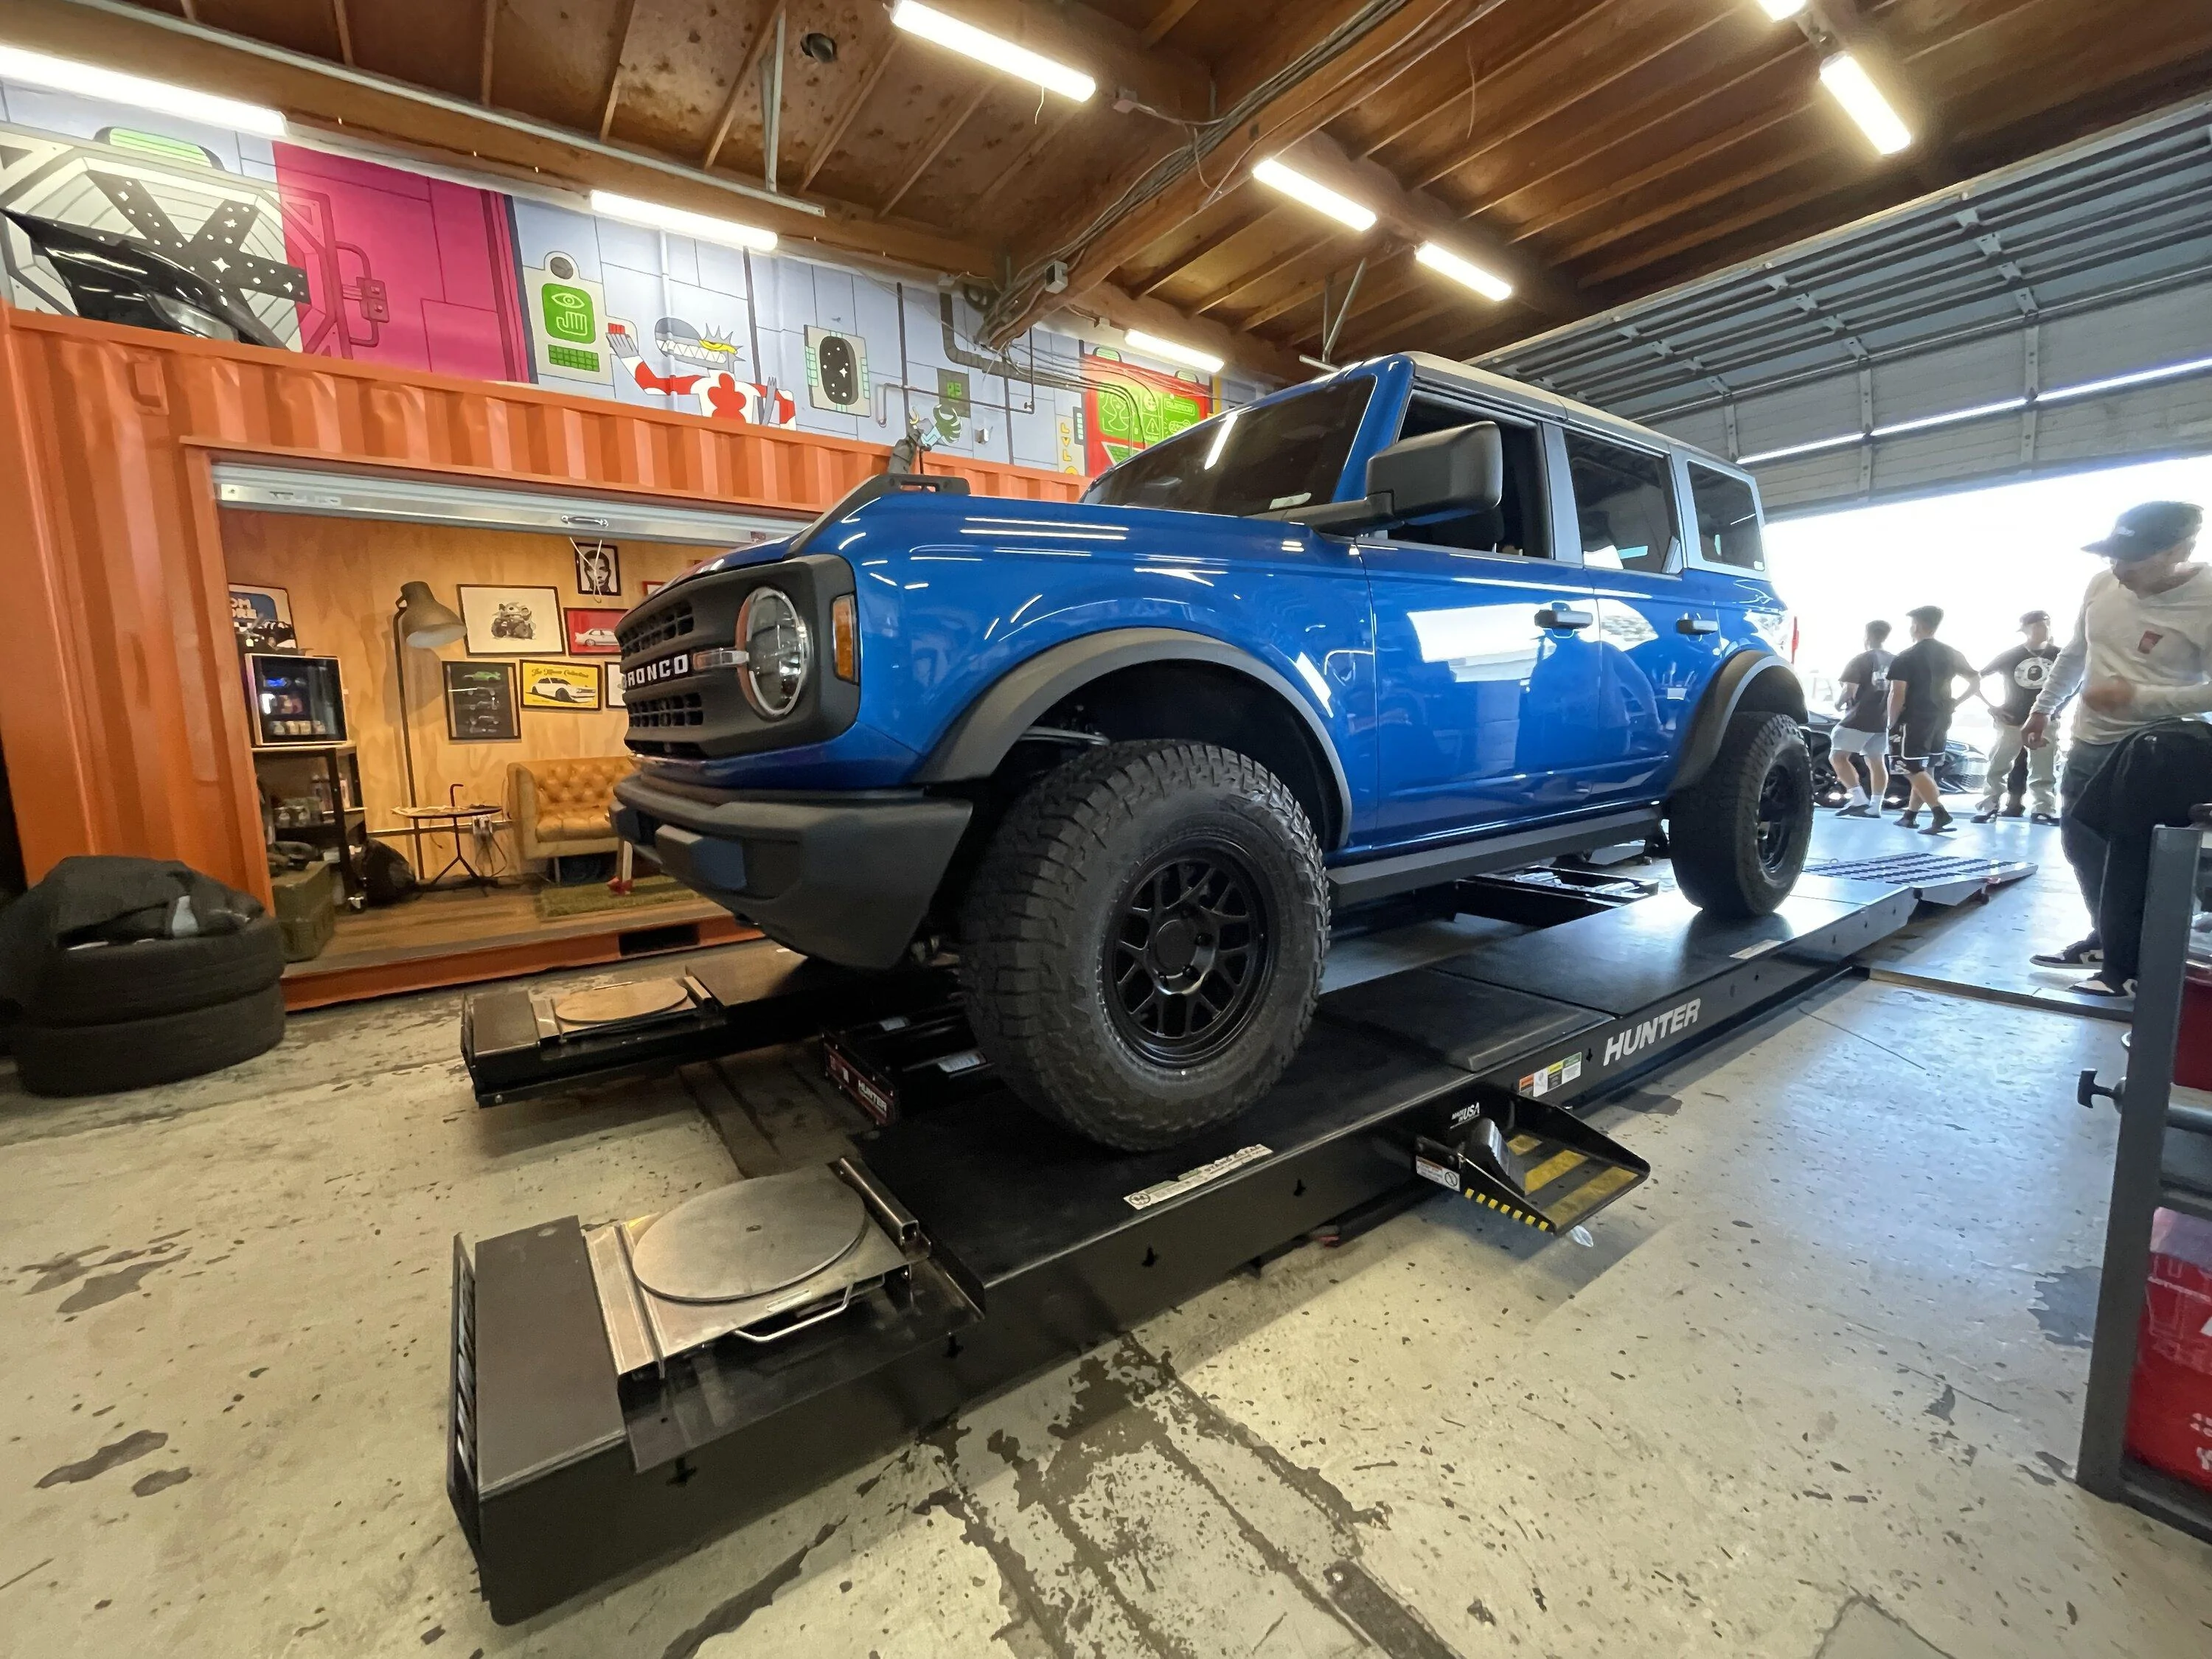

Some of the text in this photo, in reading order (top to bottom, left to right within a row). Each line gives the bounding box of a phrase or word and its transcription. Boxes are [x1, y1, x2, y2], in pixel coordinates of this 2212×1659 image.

[1603, 998, 1701, 1066] HUNTER
[858, 1079, 887, 1112] HUNTER
[1463, 1102, 1481, 1120] USA
